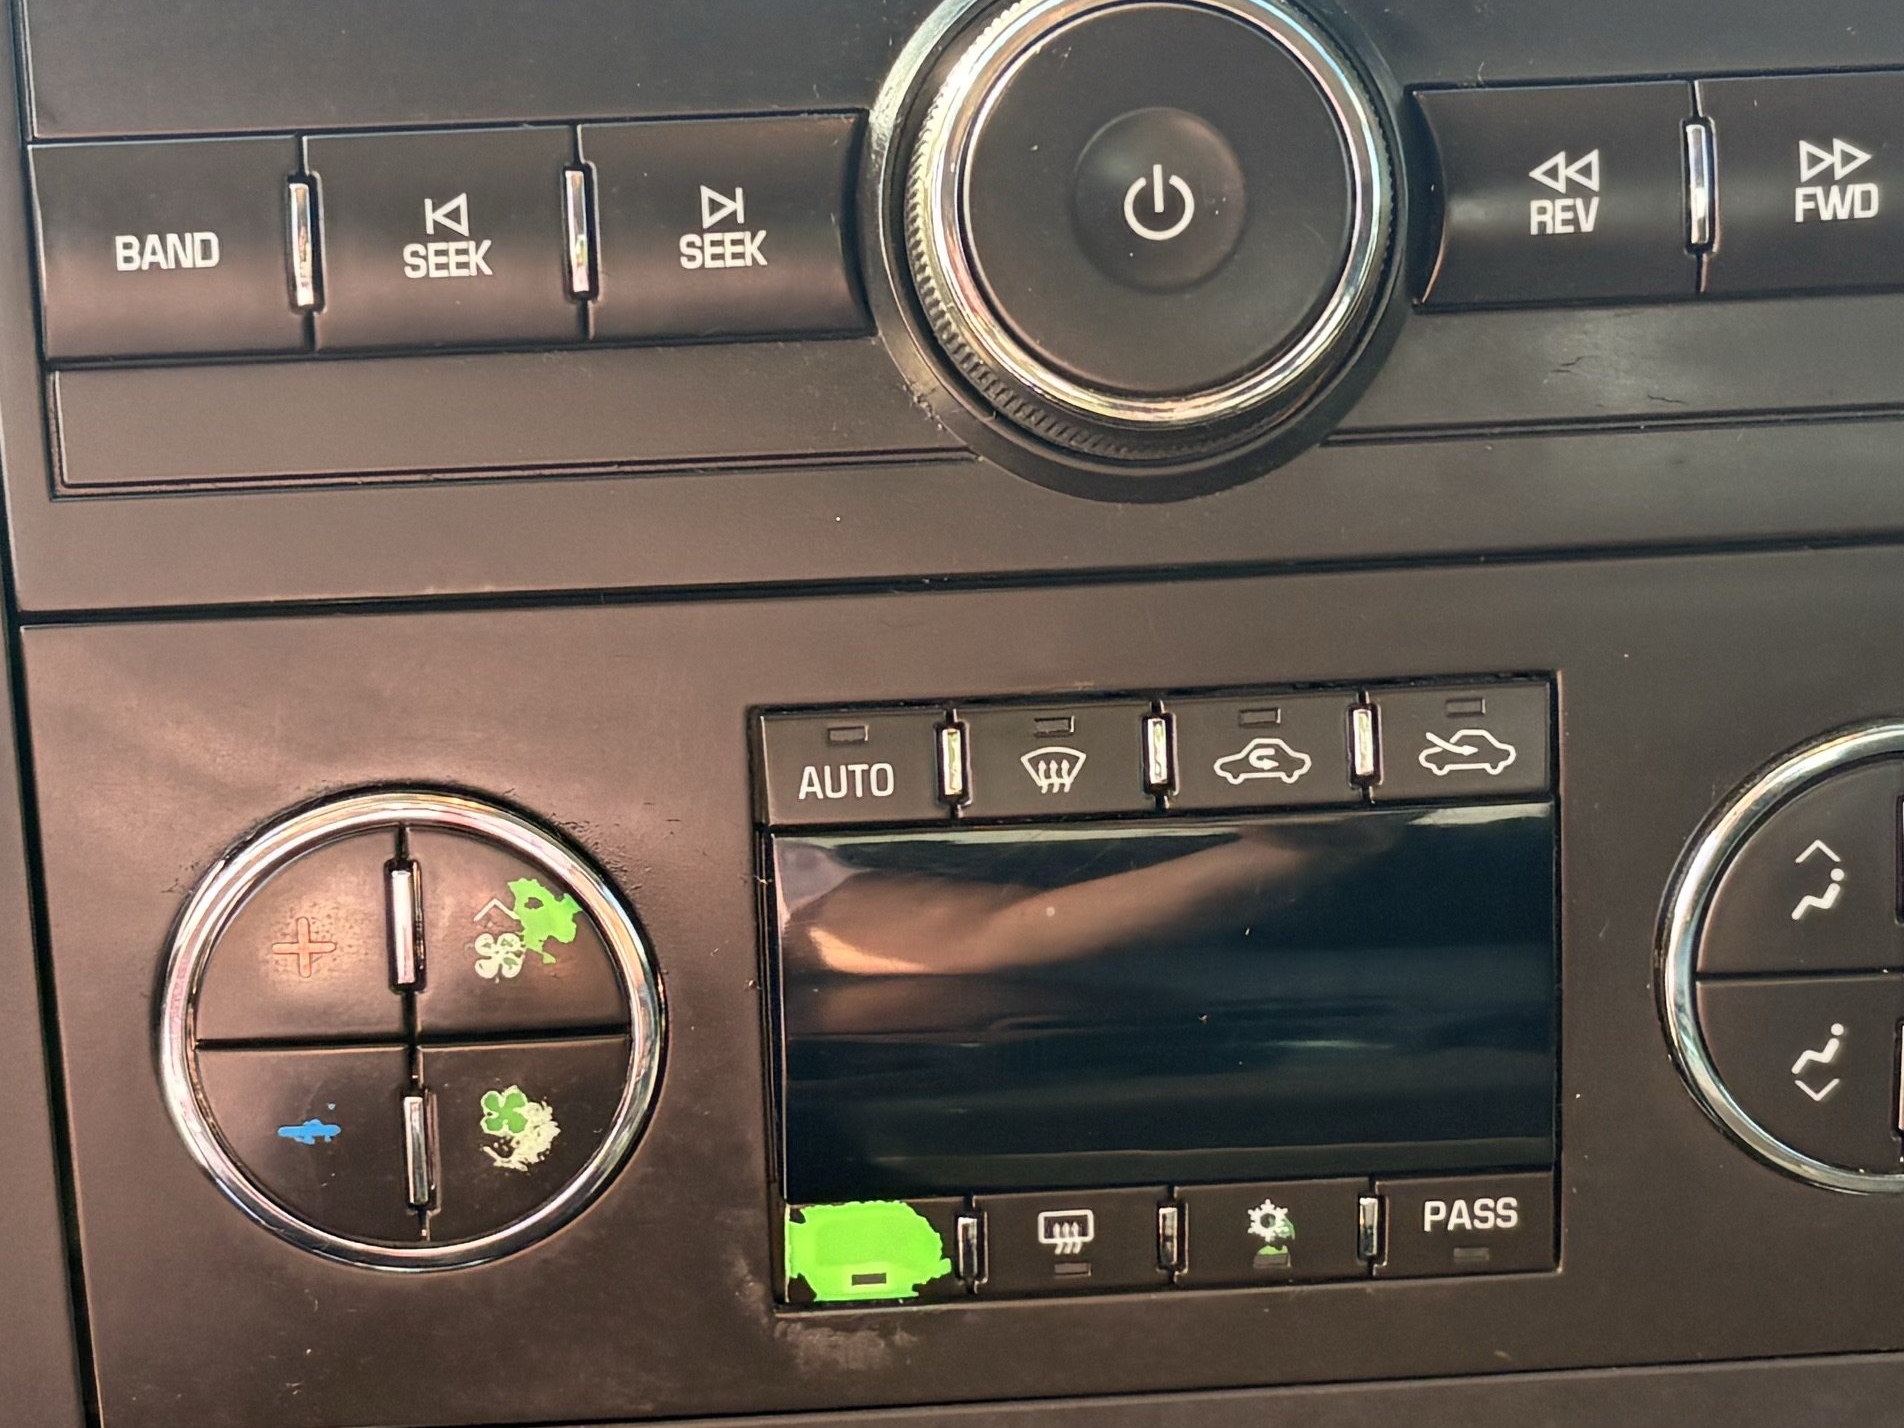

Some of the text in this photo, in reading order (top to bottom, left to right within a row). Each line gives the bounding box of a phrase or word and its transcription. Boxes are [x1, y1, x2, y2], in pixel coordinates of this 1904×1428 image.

[1530, 198, 1598, 235] REV
[1795, 183, 1877, 223] FWD
[115, 231, 220, 272] BAND
[403, 240, 493, 279] SEEK
[679, 230, 768, 270] SEEK
[798, 763, 894, 800] AUTO
[1424, 1196, 1518, 1232] PASS
